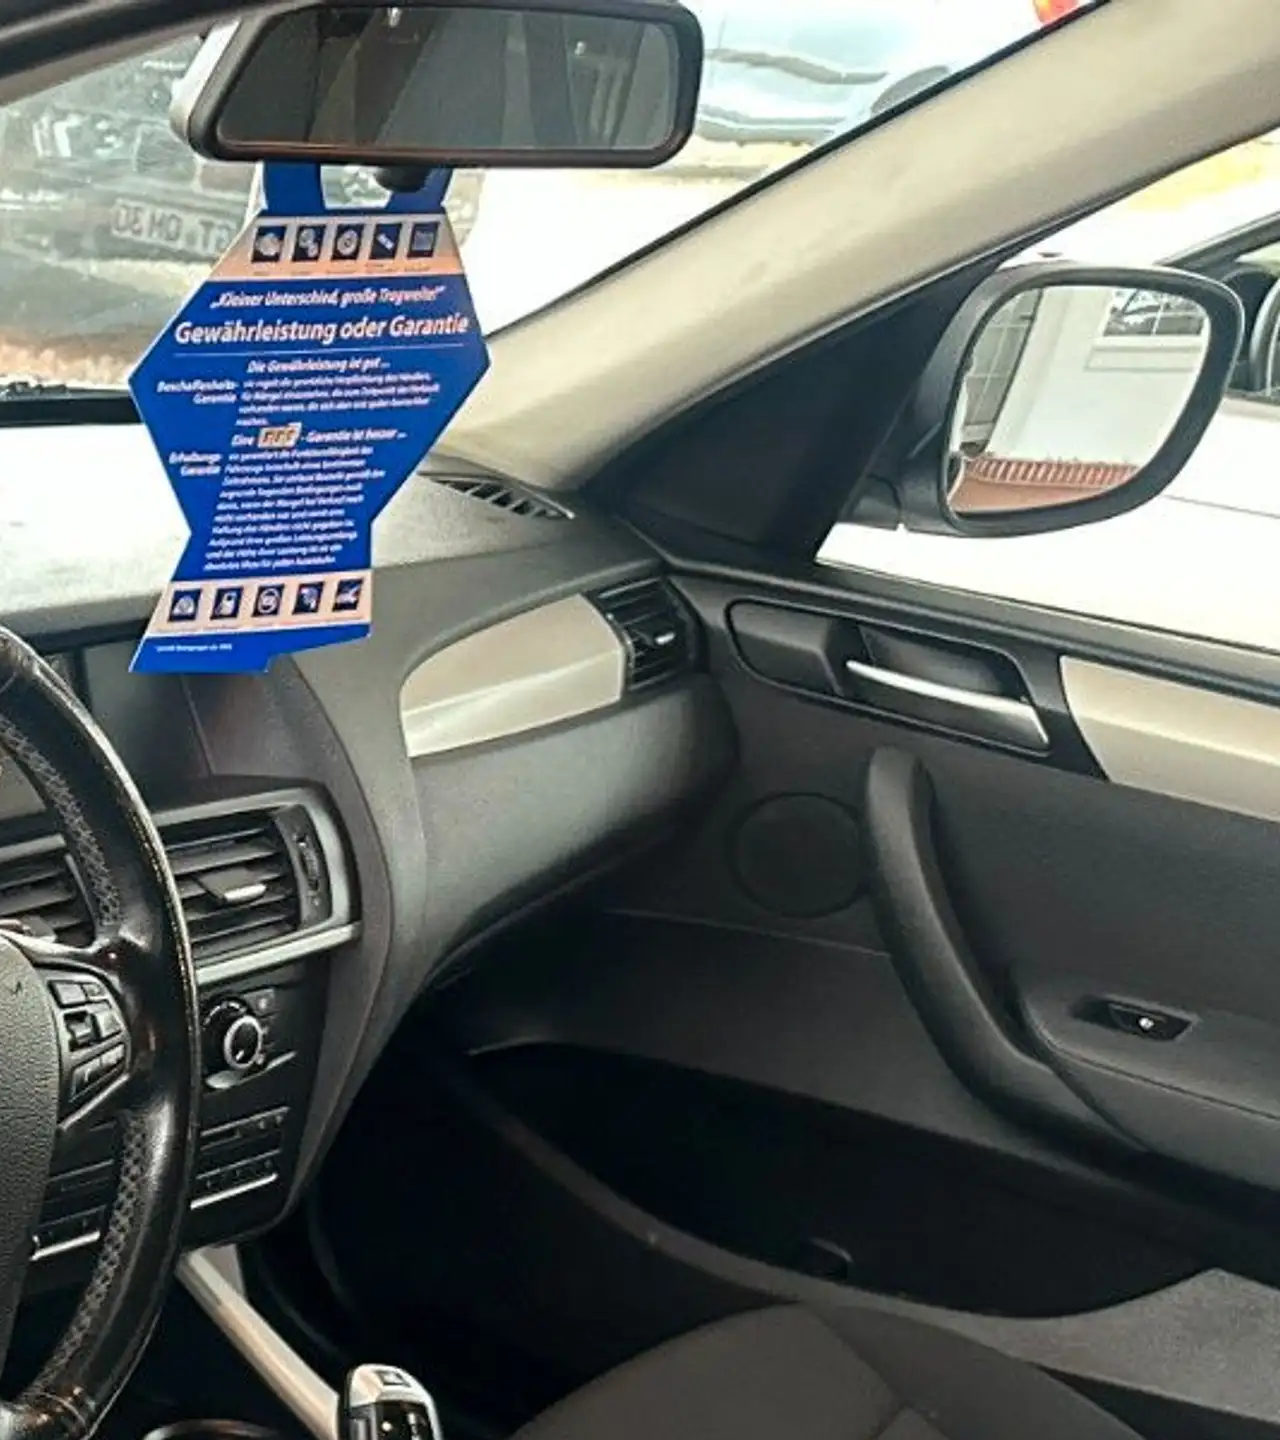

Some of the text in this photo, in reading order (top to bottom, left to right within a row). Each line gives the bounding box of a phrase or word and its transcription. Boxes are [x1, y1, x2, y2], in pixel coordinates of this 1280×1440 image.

[340, 287, 377, 308] große
[175, 312, 469, 345] Gewährleistung oder Garantie
[246, 360, 266, 374] Die
[268, 357, 346, 373] Gewährleistung
[348, 358, 361, 370] ist
[192, 392, 238, 405] Garantie
